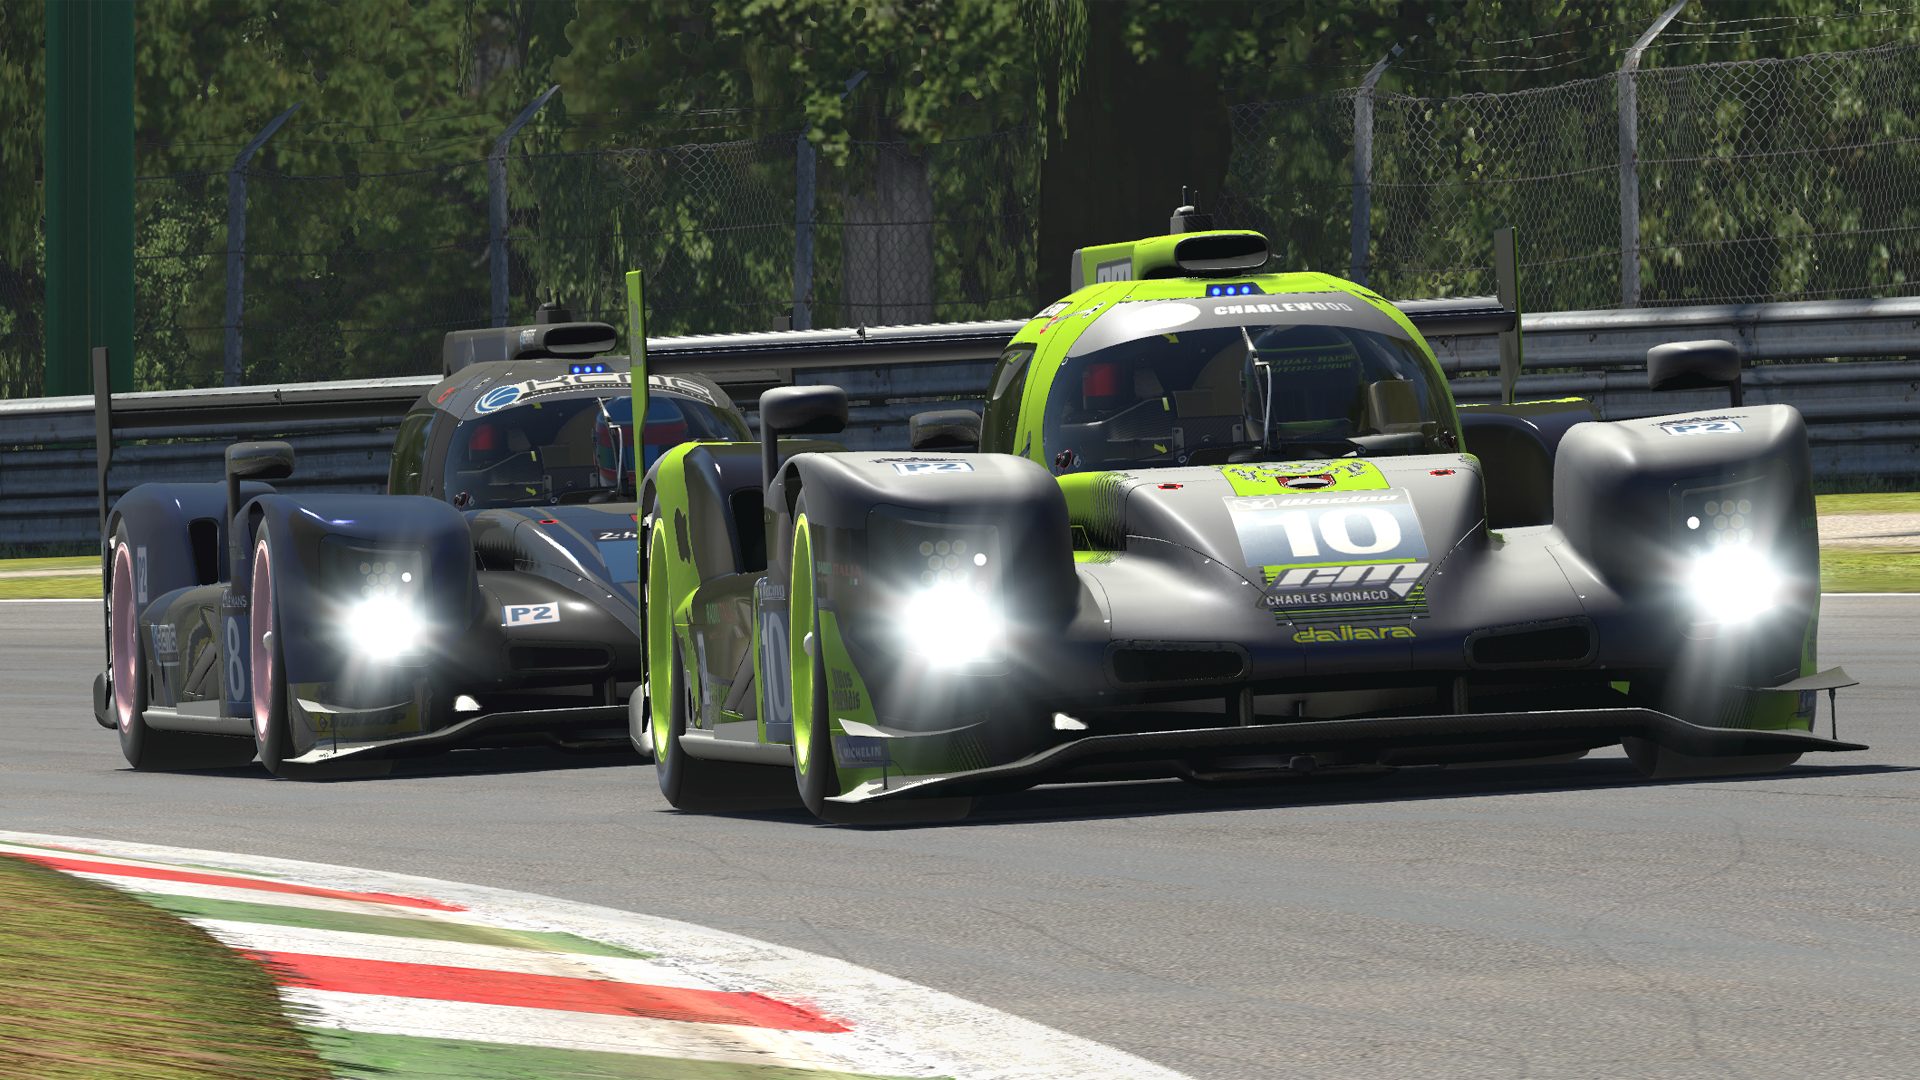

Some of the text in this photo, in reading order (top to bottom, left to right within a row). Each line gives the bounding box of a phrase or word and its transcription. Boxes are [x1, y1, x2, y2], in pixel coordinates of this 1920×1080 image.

[1214, 301, 1353, 315] CHARLEWOOD
[1672, 423, 1730, 433] P2
[904, 463, 961, 472] P2
[1247, 507, 1402, 557] 10
[1266, 590, 1388, 606] CHARLES MONACO
[511, 605, 554, 622] P2
[1293, 625, 1417, 643] dallara
[227, 616, 245, 702] 8
[761, 612, 790, 721] 10
